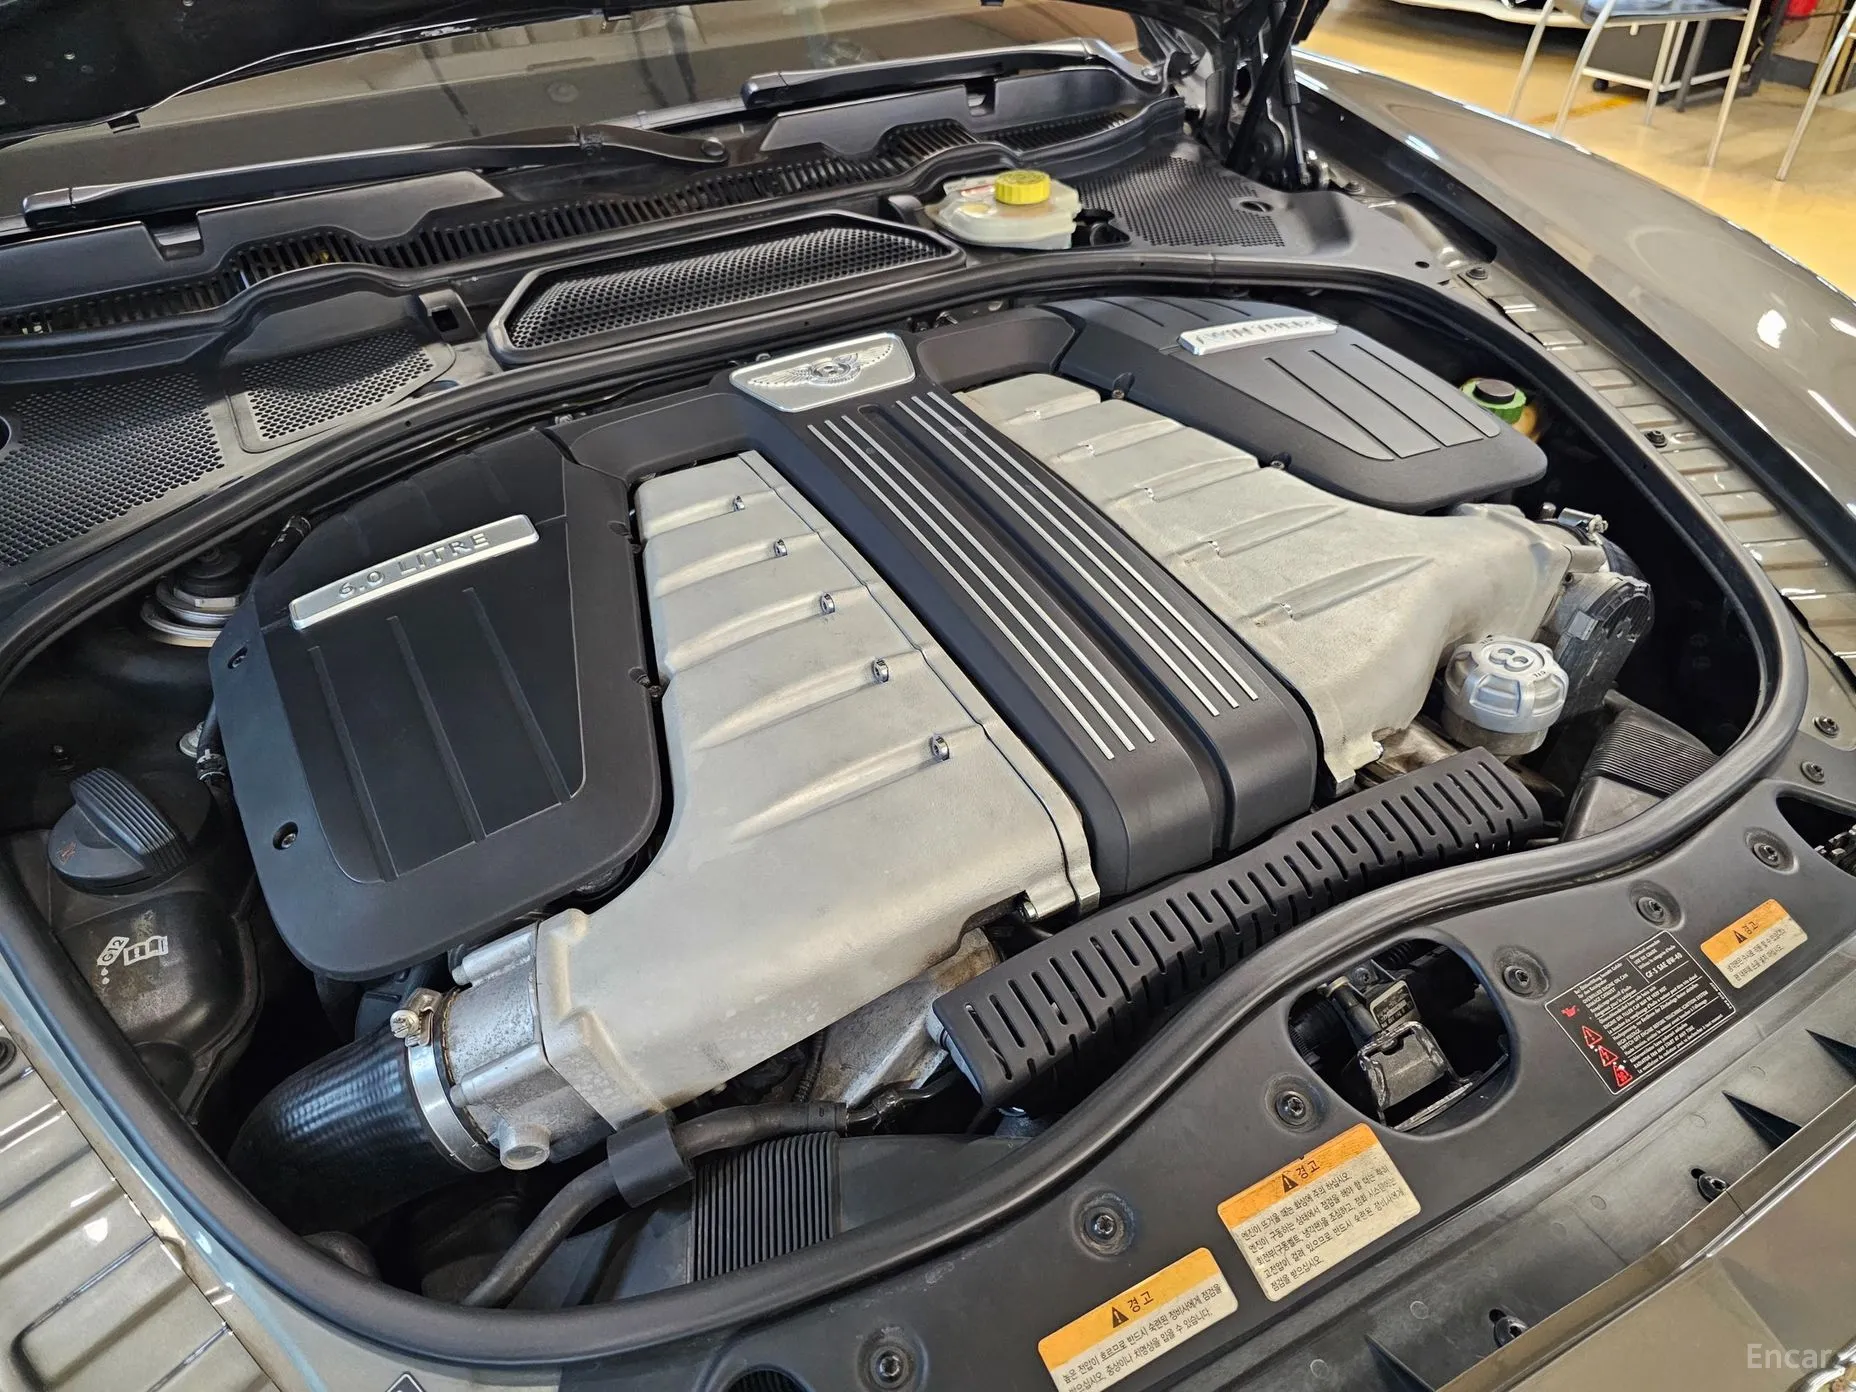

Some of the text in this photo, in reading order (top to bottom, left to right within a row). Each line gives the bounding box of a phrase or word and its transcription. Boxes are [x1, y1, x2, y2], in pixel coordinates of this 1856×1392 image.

[338, 532, 490, 599] 6.0 LITRE
[101, 939, 125, 962] G12
[1741, 921, 1758, 934] 경고
[1295, 1160, 1319, 1178] 경고
[1241, 1224, 1261, 1240] 엔진이
[1260, 1212, 1280, 1229] 뜨거울
[1280, 1206, 1294, 1217] 때는
[1293, 1193, 1313, 1209] 화상에
[1312, 1185, 1326, 1198] 주의
[1248, 1236, 1269, 1253] 엔진이
[1269, 1222, 1295, 1240] 구동하는
[1295, 1205, 1320, 1225] 상태에서
[1320, 1194, 1340, 1210] 점검을
[1339, 1185, 1353, 1197] 해야
[1264, 1256, 1290, 1278] 고전압이
[1305, 1232, 1332, 1252] 있으므로
[1332, 1219, 1353, 1236] 반드시
[1127, 1291, 1153, 1312] 경고
[1270, 1274, 1290, 1291] 점검을
[1062, 1283, 1221, 1383] 높은 전압이 흐르므로 반드시 숙련된 정비사에게 점검을
[1106, 1353, 1132, 1375] 중상이나
[1134, 1337, 1160, 1357] 치명상을
[1160, 1328, 1174, 1342] 입을
[1175, 1324, 1182, 1332] 수
